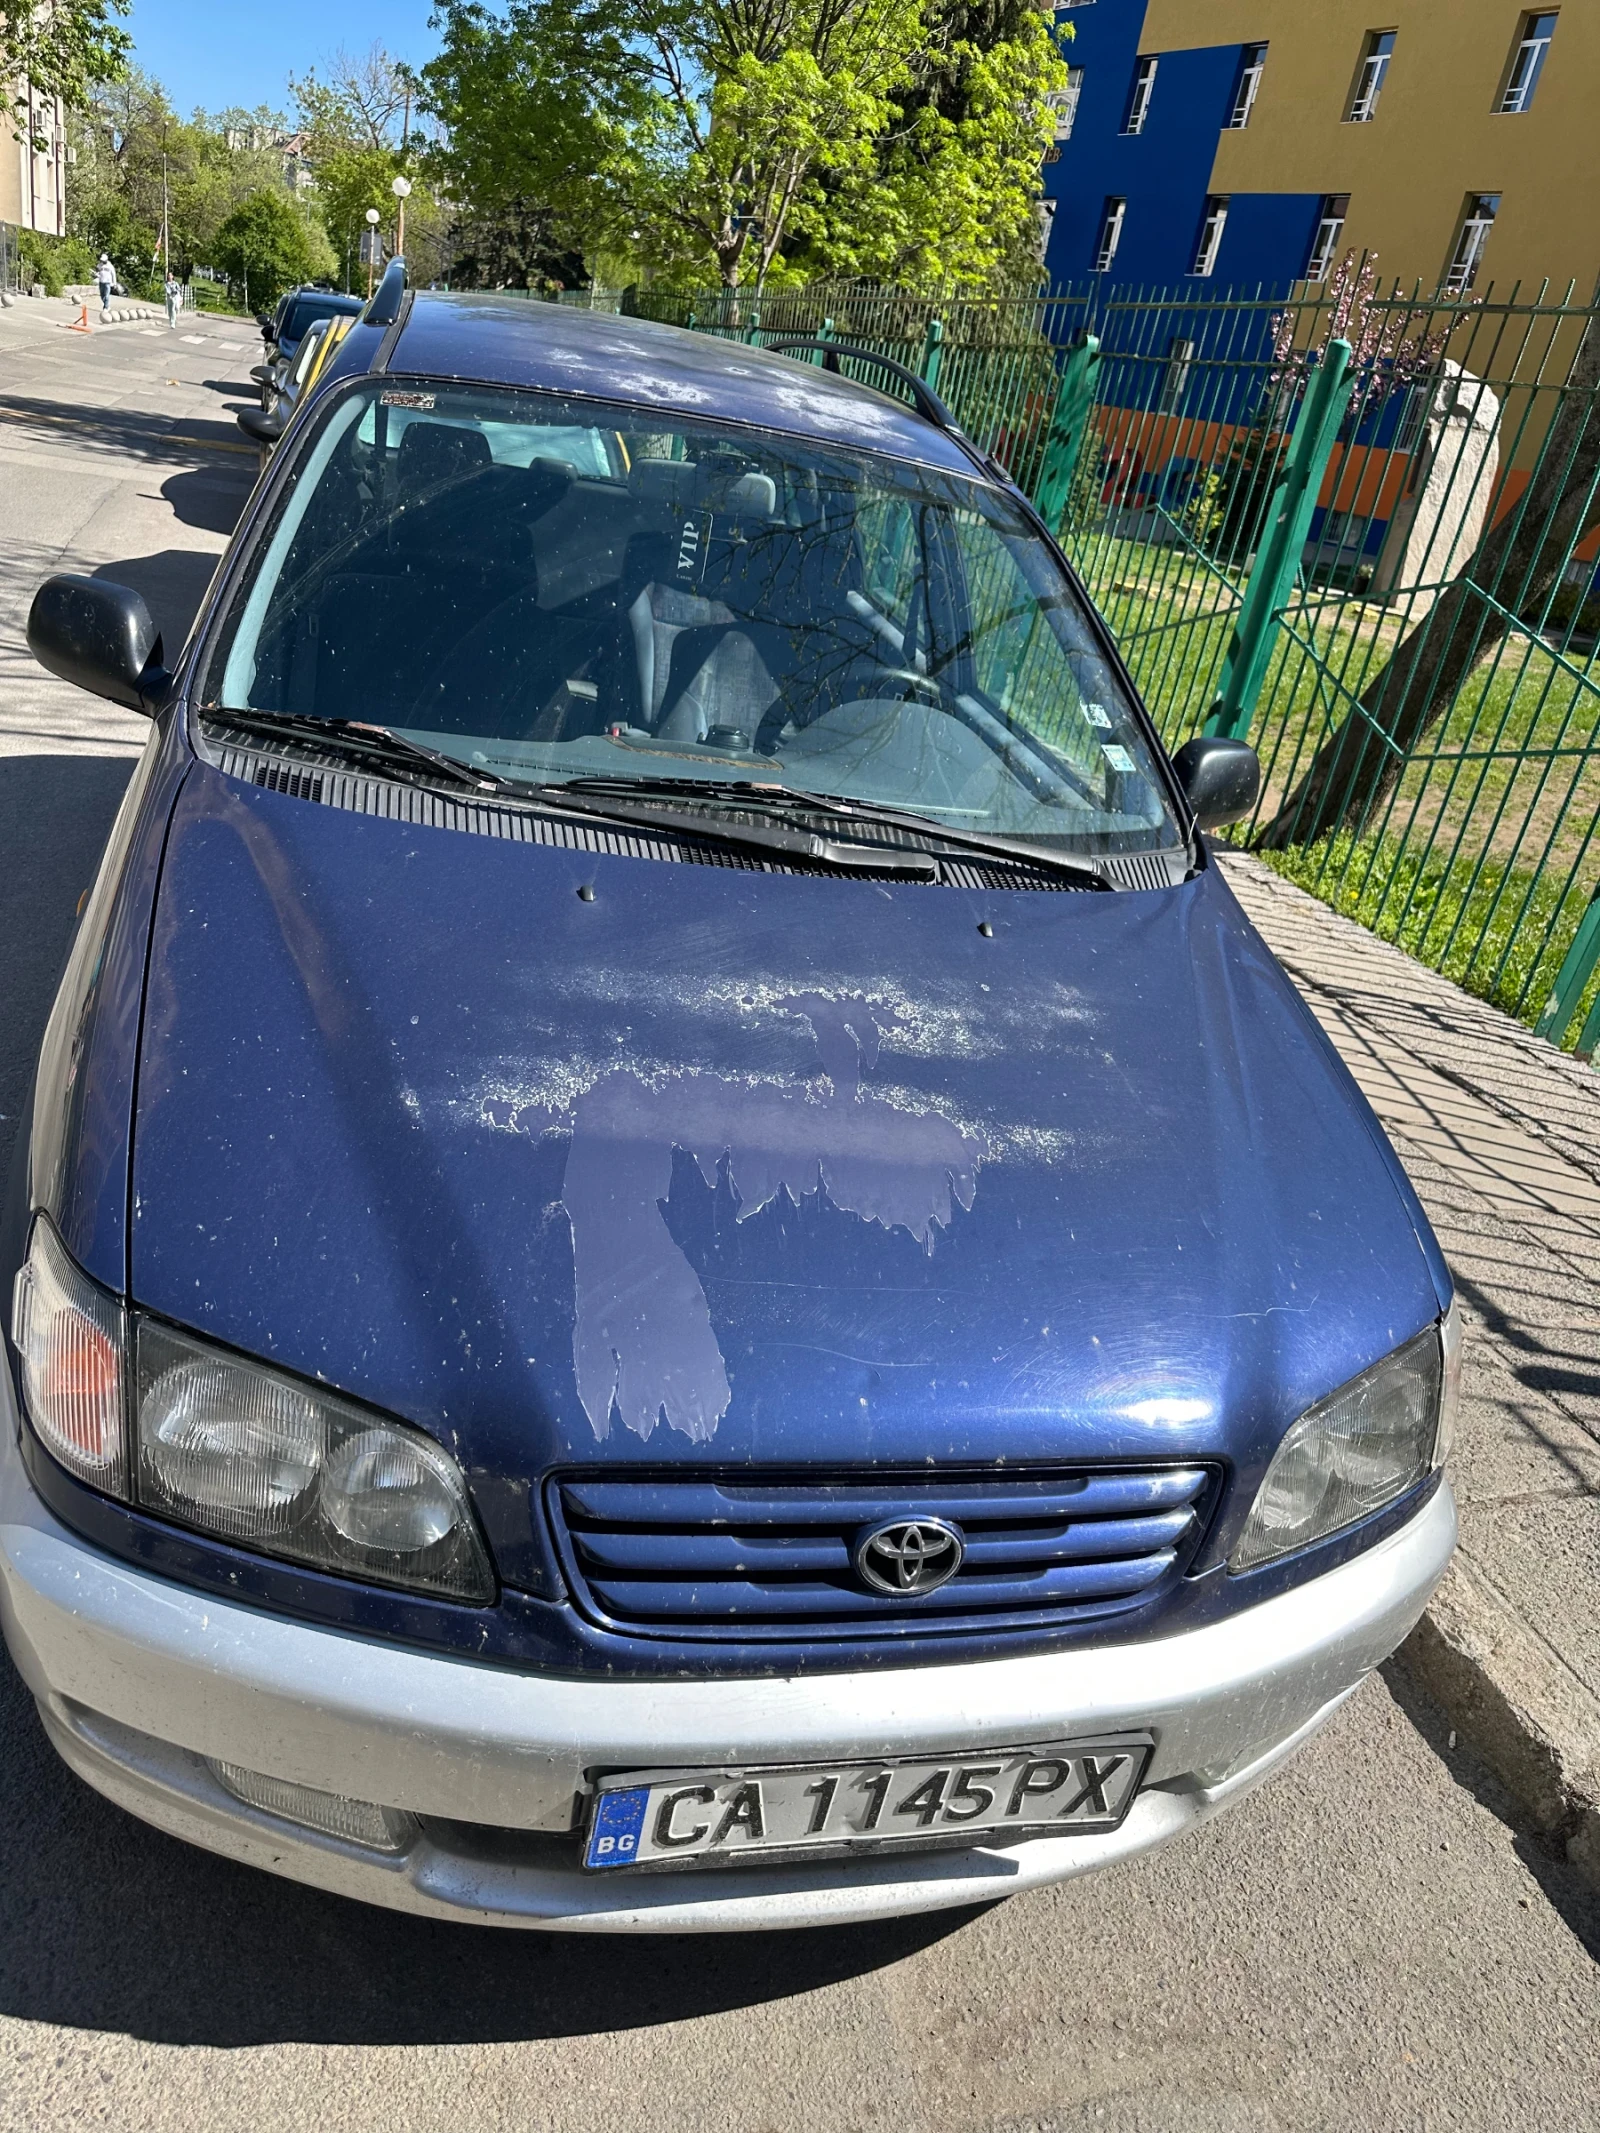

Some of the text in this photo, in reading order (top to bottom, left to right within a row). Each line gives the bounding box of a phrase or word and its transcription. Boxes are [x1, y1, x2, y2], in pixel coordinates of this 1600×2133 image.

[677, 521, 699, 569] VIP
[652, 1754, 1130, 1848] CA 1145 PX
[597, 1834, 636, 1854] BG
